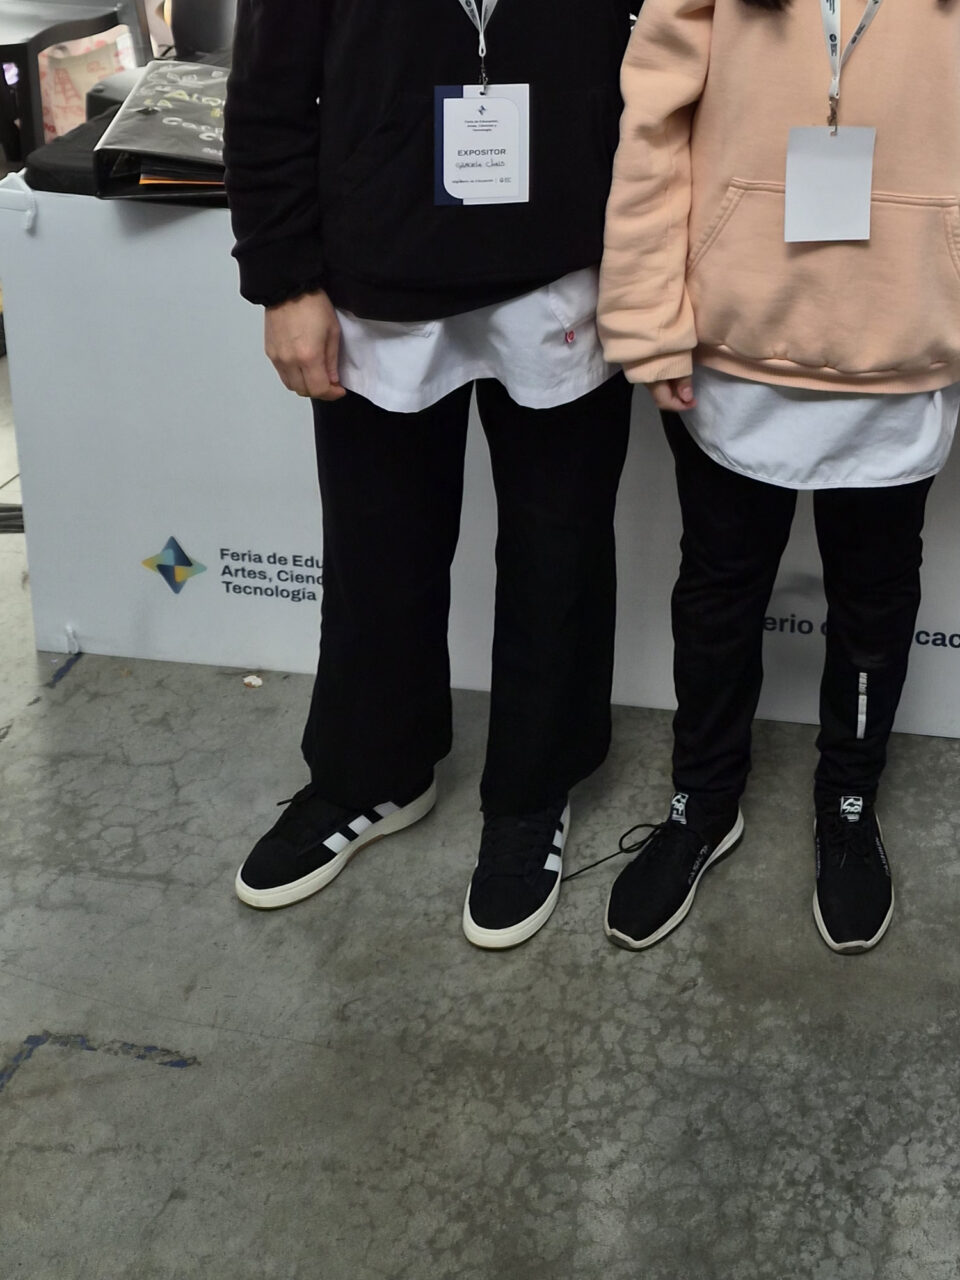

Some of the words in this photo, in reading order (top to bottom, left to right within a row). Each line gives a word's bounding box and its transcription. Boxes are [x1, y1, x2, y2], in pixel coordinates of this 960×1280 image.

[457, 148, 506, 157] EXPOSITOR
[219, 548, 263, 564] Feria
[267, 553, 288, 567] de
[221, 565, 273, 582] Artes,
[277, 570, 323, 585] Cienc
[221, 580, 316, 603] Tecnología
